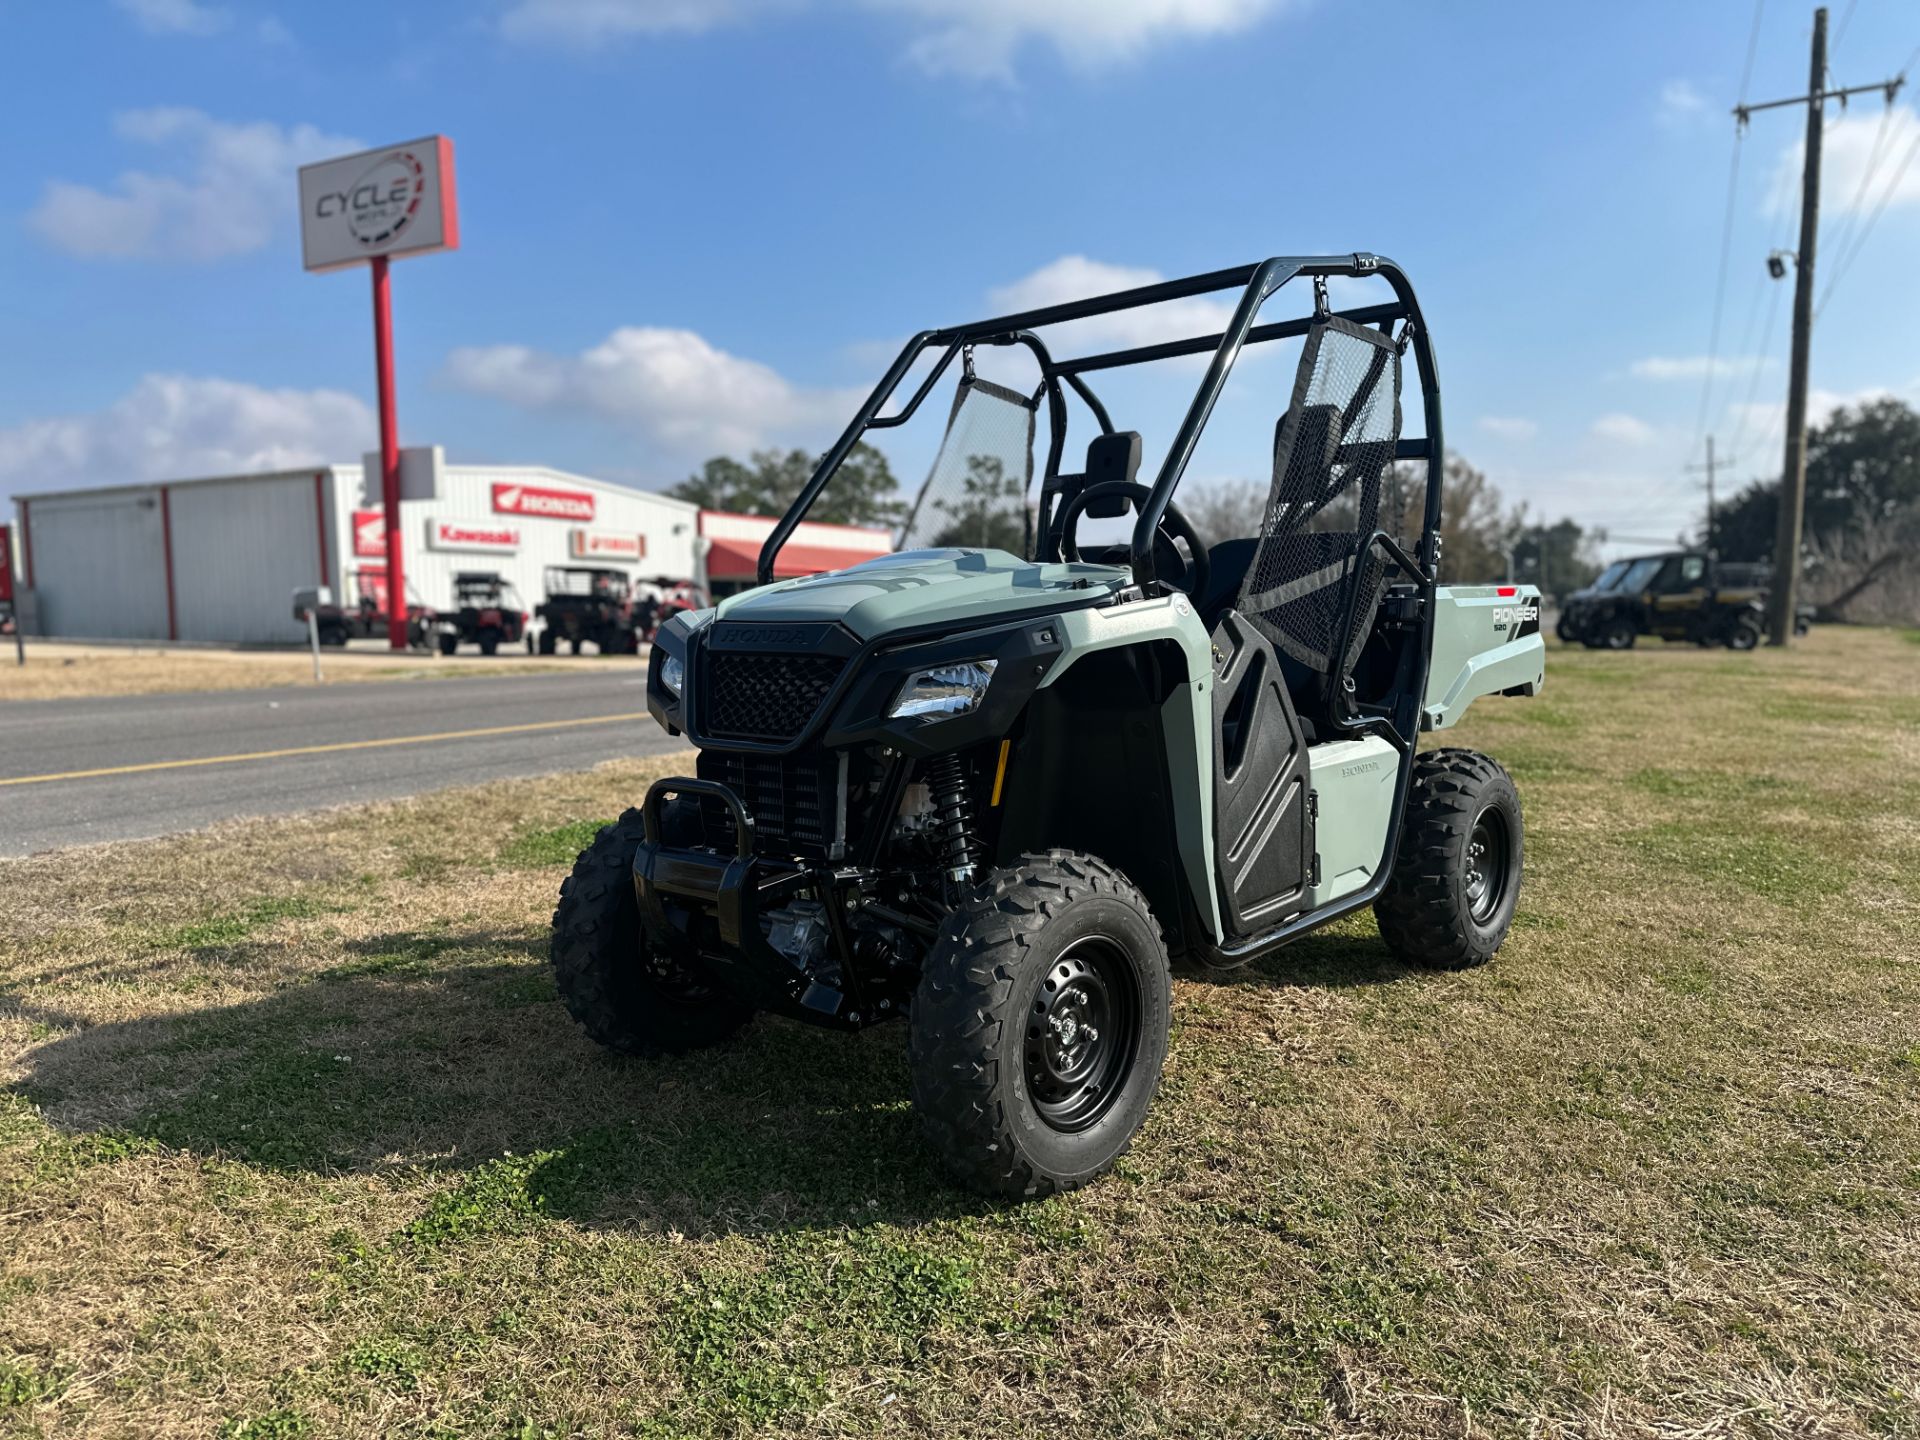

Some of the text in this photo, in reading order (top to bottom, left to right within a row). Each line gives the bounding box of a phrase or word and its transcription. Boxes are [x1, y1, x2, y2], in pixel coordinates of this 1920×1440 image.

[316, 177, 408, 218] CYCLE
[521, 494, 592, 515] HONDA
[440, 525, 519, 545] Kawasaki
[1493, 606, 1538, 623] PIONEER
[1493, 623, 1507, 631] 520
[720, 628, 809, 645] HONDA
[1341, 761, 1380, 777] HONDA
